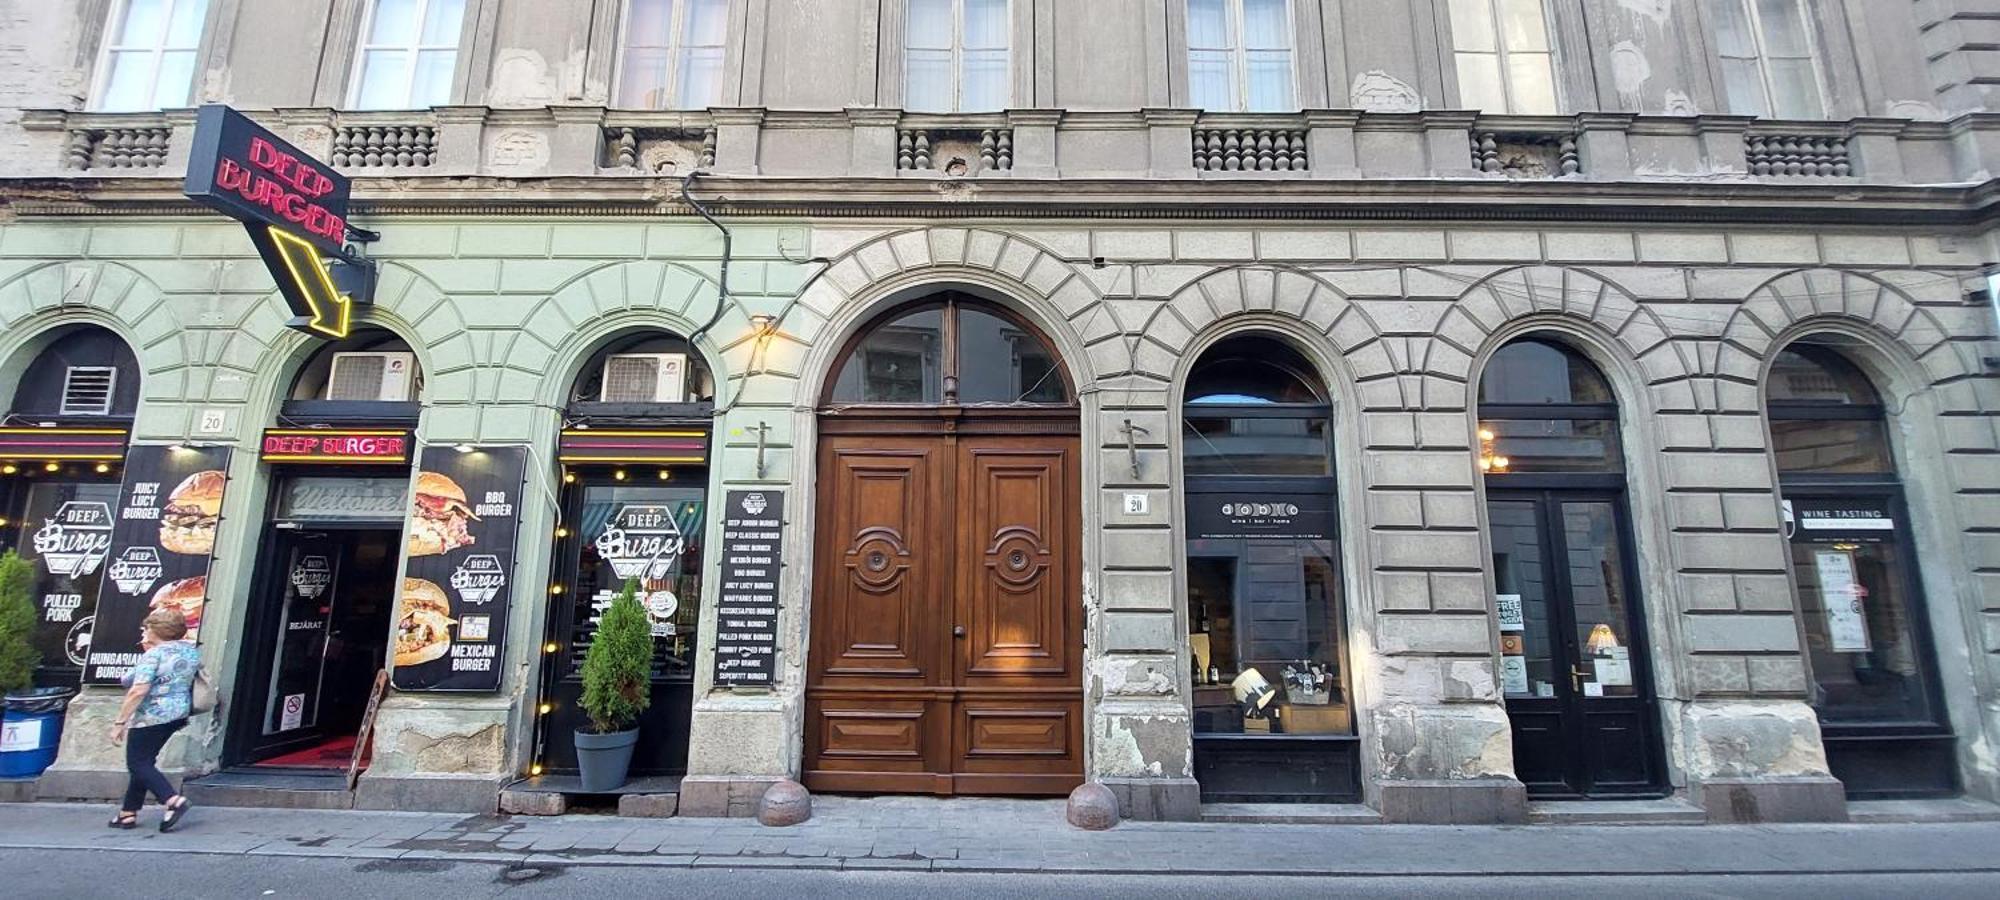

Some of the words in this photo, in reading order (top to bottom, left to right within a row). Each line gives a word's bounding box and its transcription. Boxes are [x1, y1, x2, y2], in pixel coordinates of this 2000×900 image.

[249, 137, 333, 198] DEEP
[216, 158, 344, 244] BURGER
[204, 417, 220, 429] 20
[265, 437, 319, 453] DEEP
[323, 437, 404, 454] BURGER
[133, 482, 160, 494] JUICY
[131, 495, 156, 507] LUCY
[485, 491, 506, 504] BBQ
[475, 504, 512, 516] BURGER
[1130, 499, 1143, 512] 20
[66, 510, 100, 523] DEEP
[122, 508, 160, 519] BURGER
[1802, 510, 1831, 518] WINE
[1835, 510, 1882, 518] TASTING
[628, 514, 662, 528] DEEP
[33, 523, 112, 580] Burge
[130, 552, 150, 560] DEEP
[596, 525, 686, 587] Burger
[109, 556, 163, 597] Burger
[450, 566, 505, 605] Burger
[44, 594, 81, 607] PULLED
[46, 608, 72, 621] PORK
[289, 621, 323, 630] BEJÁRAT
[450, 645, 495, 657] MEXICAN
[452, 659, 491, 671] BURGER
